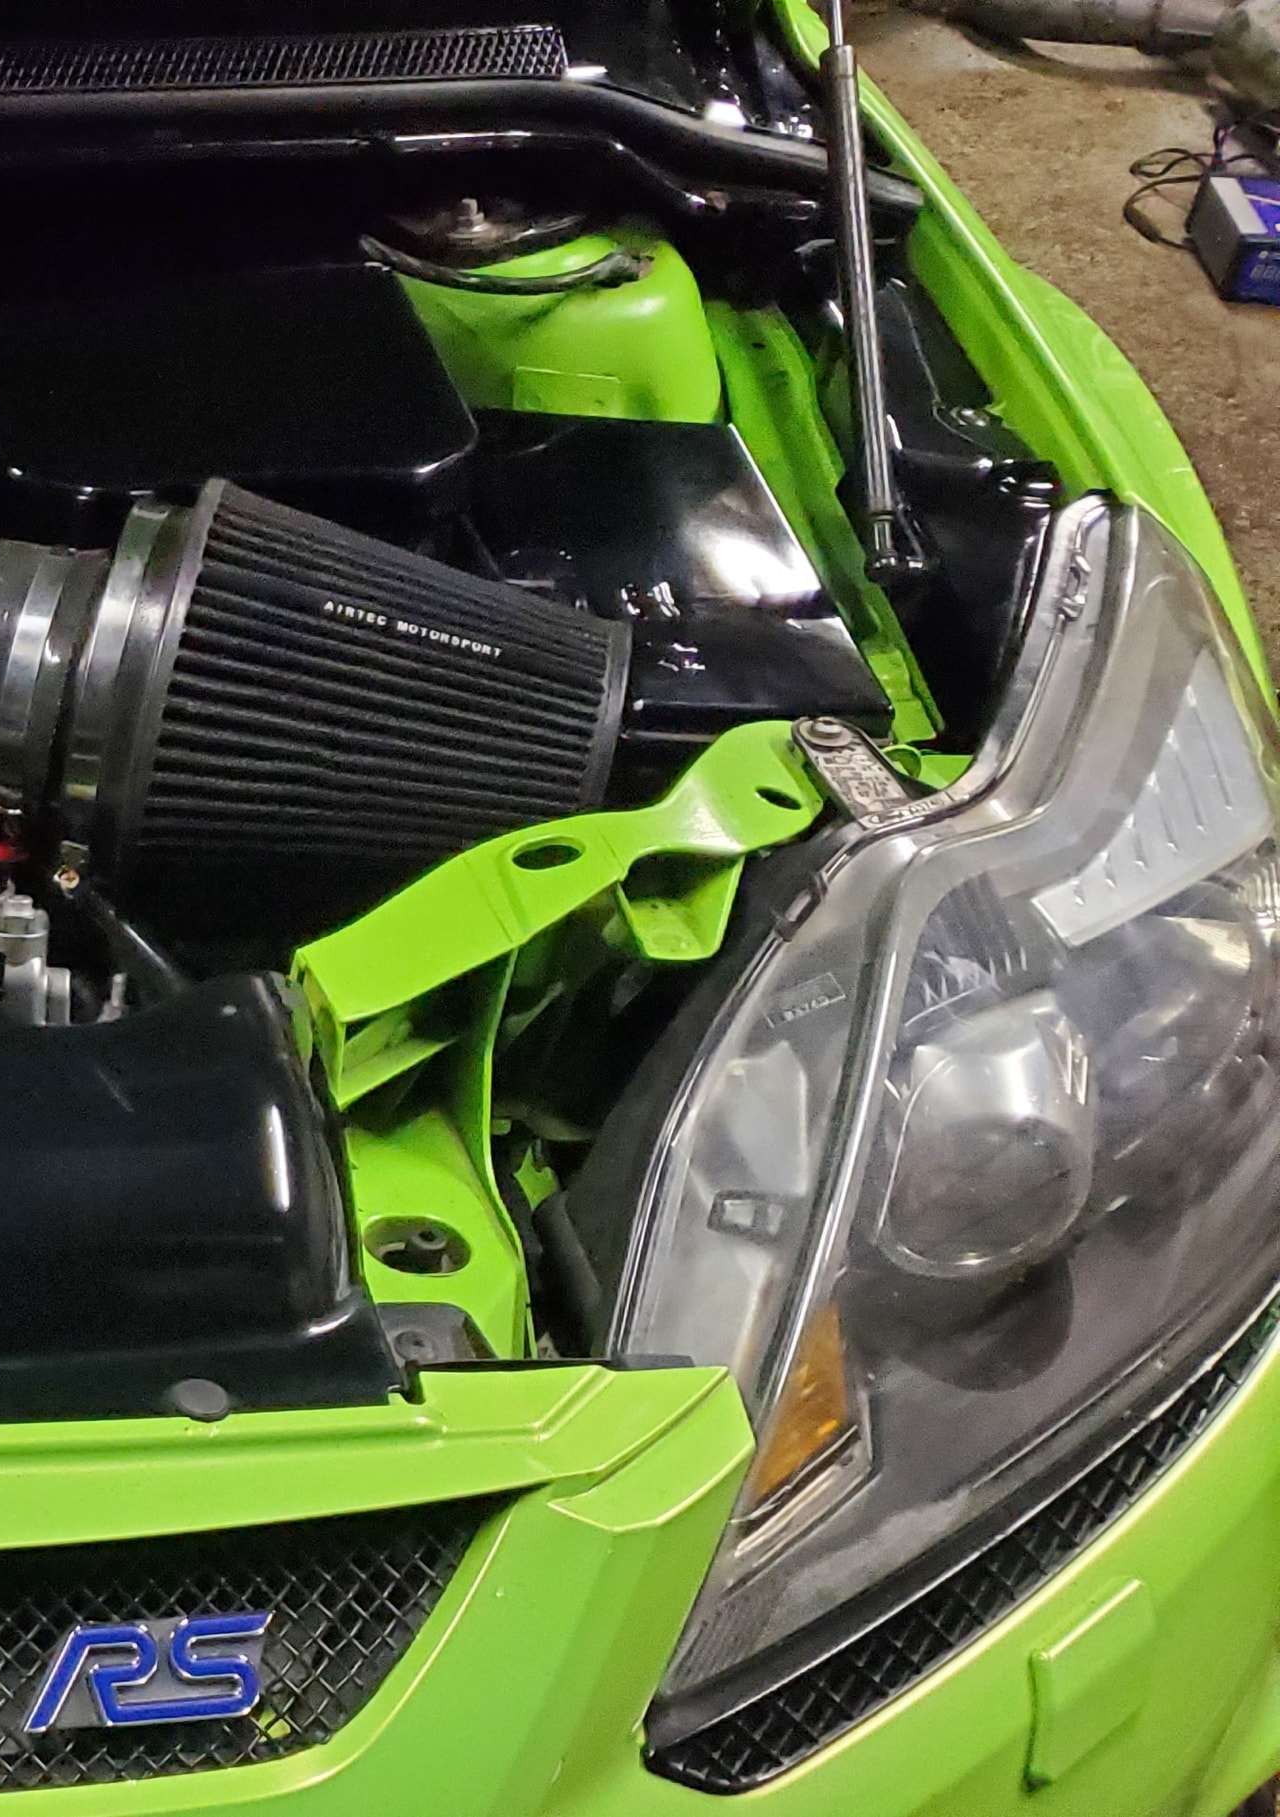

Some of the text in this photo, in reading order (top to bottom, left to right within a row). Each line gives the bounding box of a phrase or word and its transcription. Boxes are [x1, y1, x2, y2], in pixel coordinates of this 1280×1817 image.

[324, 601, 503, 658] AIRTEC MOTORSPORT
[24, 1611, 276, 1732] RS
